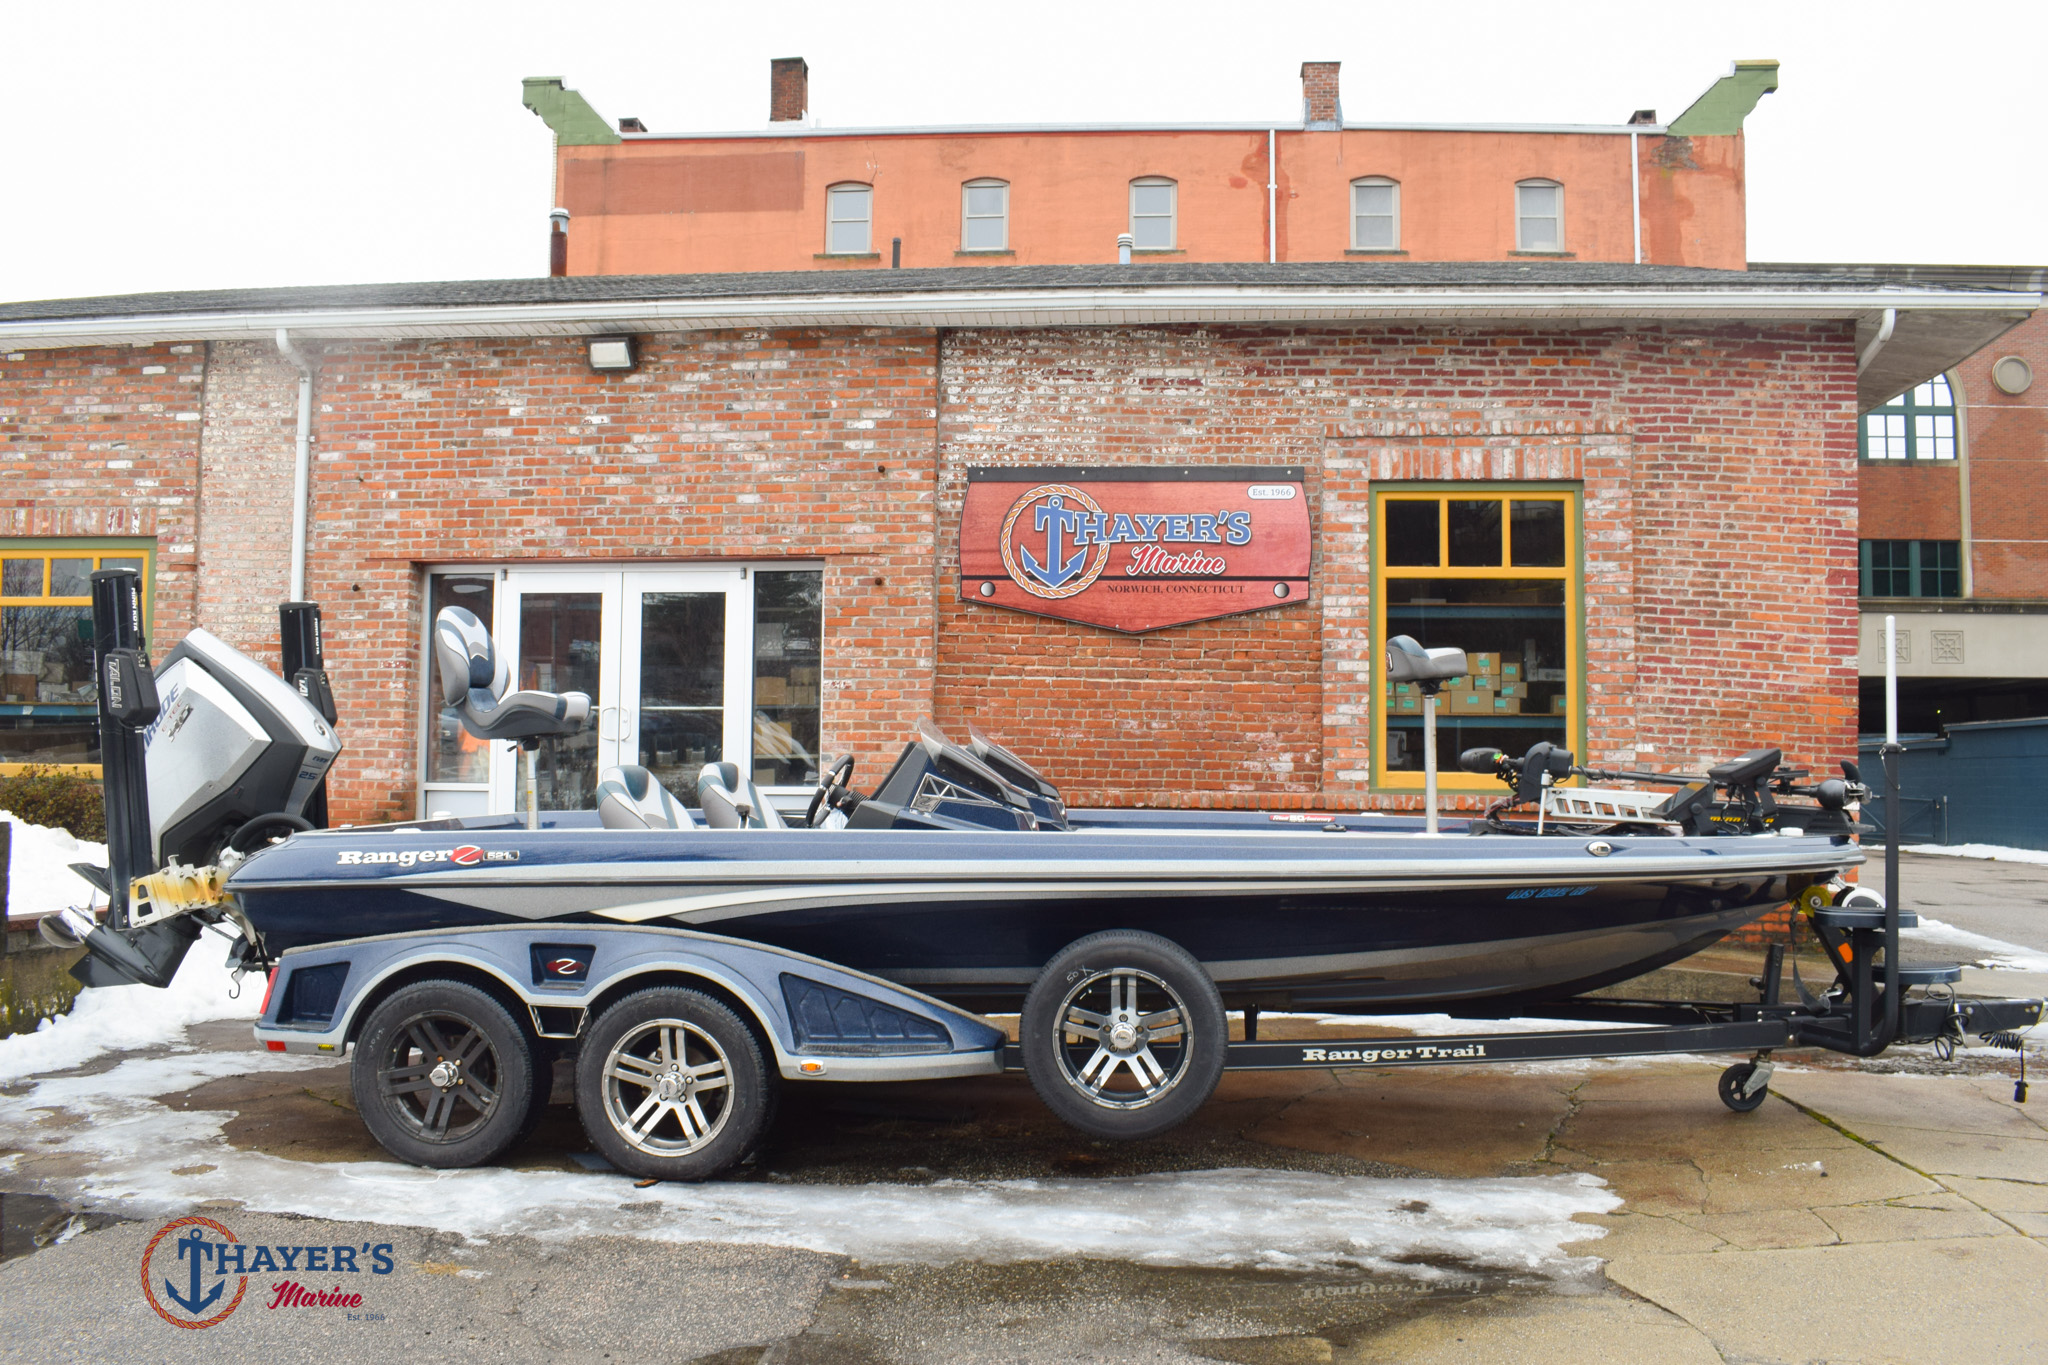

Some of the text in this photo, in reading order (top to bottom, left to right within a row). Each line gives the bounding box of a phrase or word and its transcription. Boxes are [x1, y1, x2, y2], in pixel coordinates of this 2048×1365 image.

[1252, 488, 1292, 497] Est. 1966
[1126, 544, 1226, 576] Marine
[1107, 584, 1245, 594] NORWICH, CONNECTICUT
[108, 658, 122, 709] TALON
[336, 848, 454, 867] Ranger
[1302, 1044, 1487, 1063] Ranger Trail
